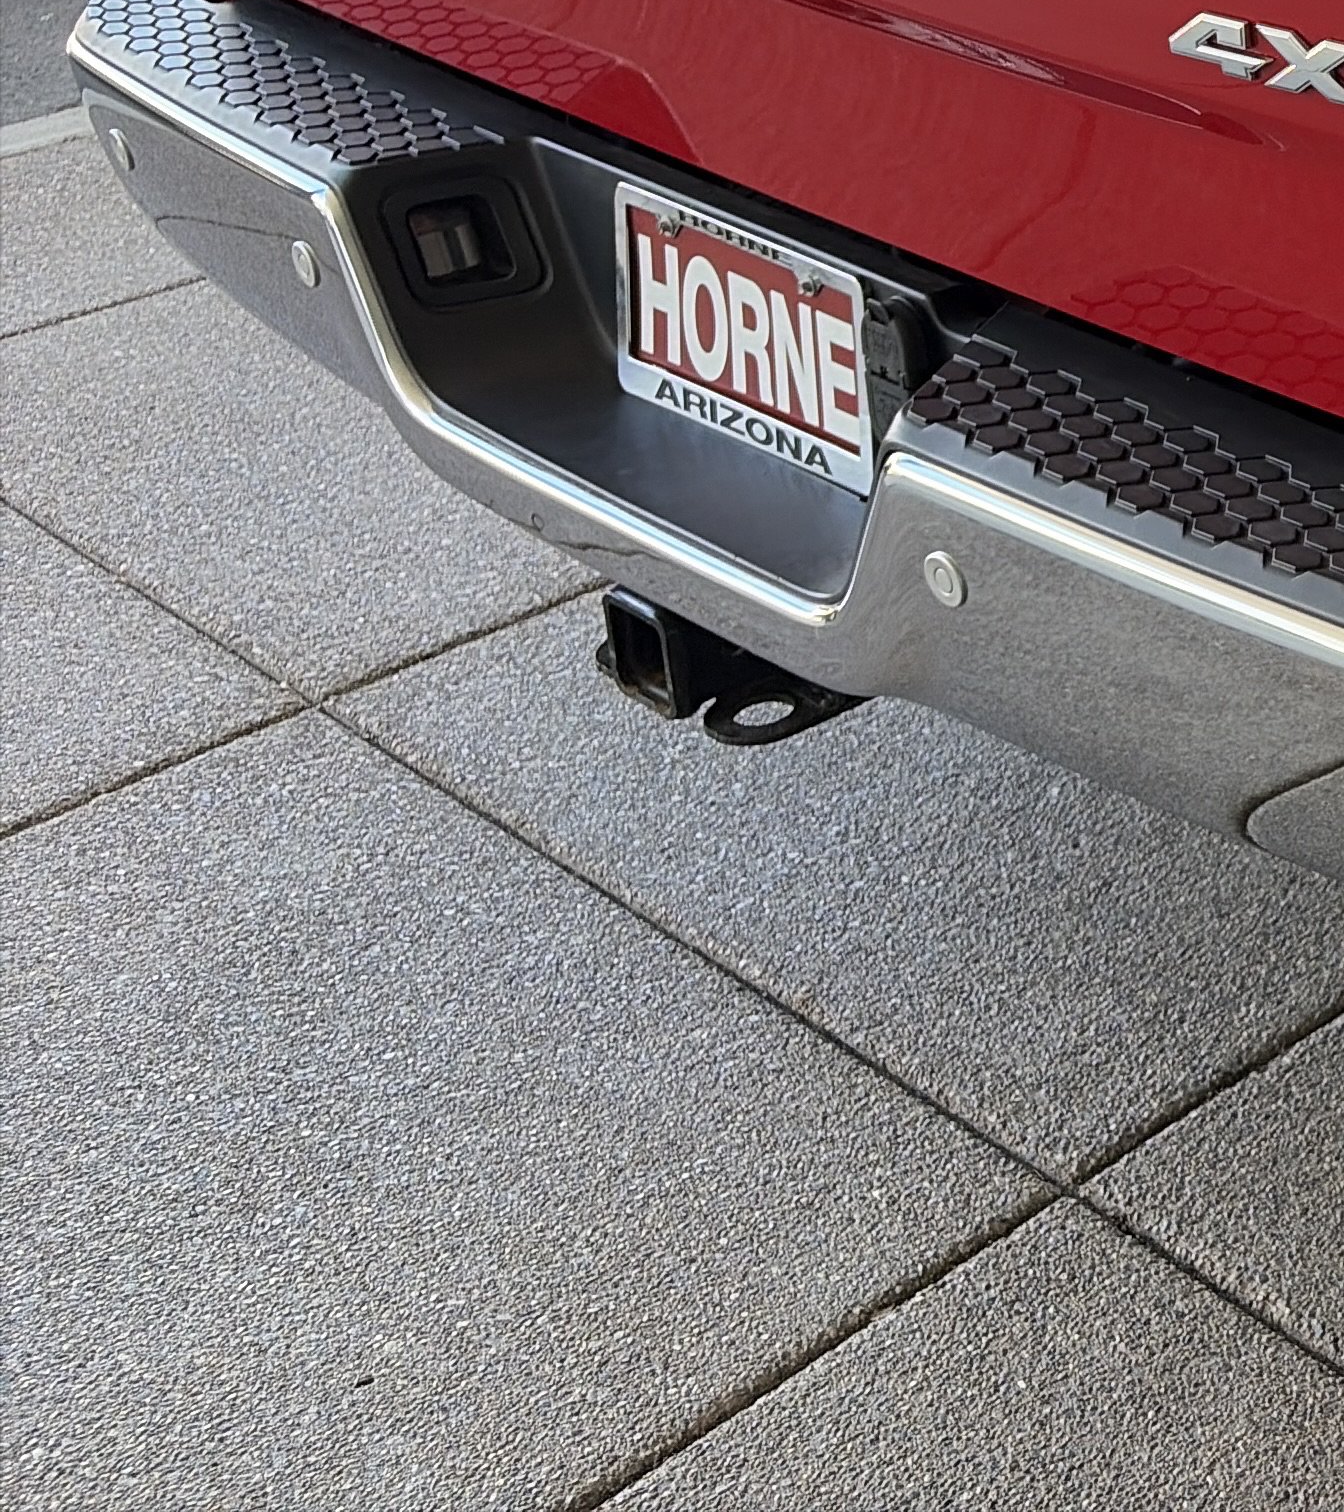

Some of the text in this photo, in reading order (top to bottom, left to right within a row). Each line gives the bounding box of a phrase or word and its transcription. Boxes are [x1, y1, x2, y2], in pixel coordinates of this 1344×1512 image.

[678, 210, 794, 267] HORNE
[637, 233, 861, 440] HORNE
[654, 378, 833, 476] ARIZONA
